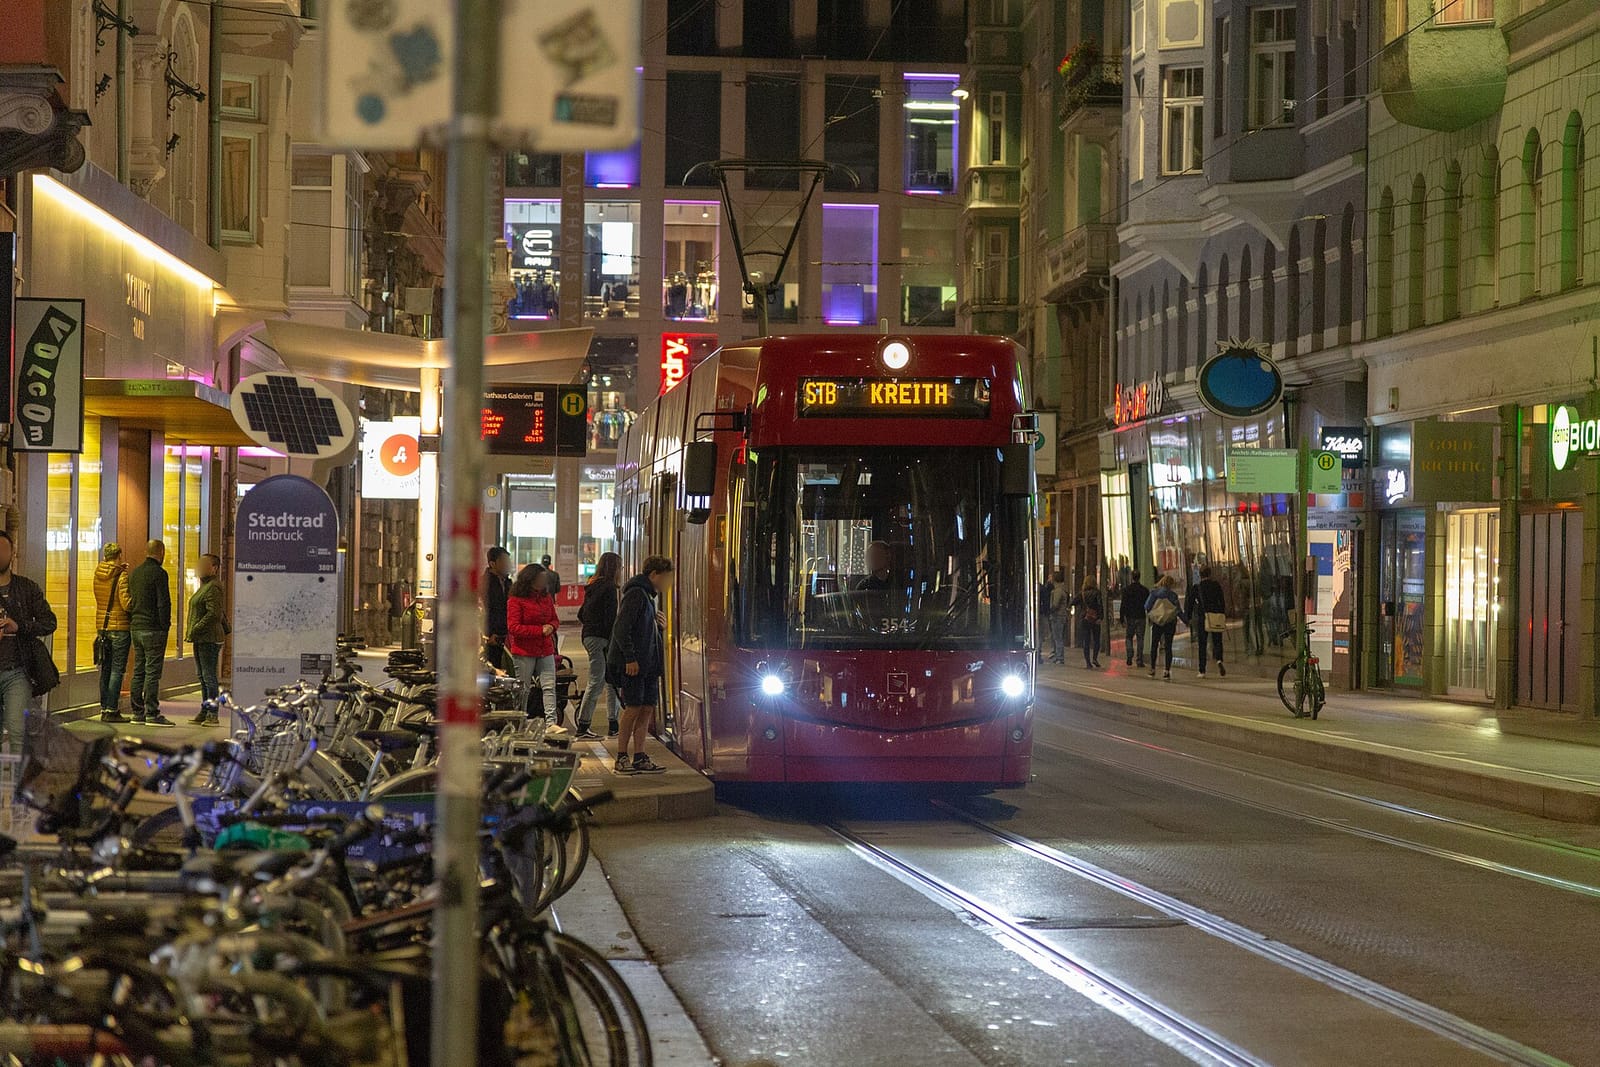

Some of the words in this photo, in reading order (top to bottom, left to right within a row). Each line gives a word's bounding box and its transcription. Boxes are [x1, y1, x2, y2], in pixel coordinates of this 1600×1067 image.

[805, 383, 836, 404] STB
[870, 383, 948, 404] KREITH
[248, 512, 323, 527] Stadtrad
[248, 530, 303, 541] Innsbruck
[237, 563, 286, 571] Rathausgalerien
[236, 666, 285, 674] stadtrad.ivb.at
